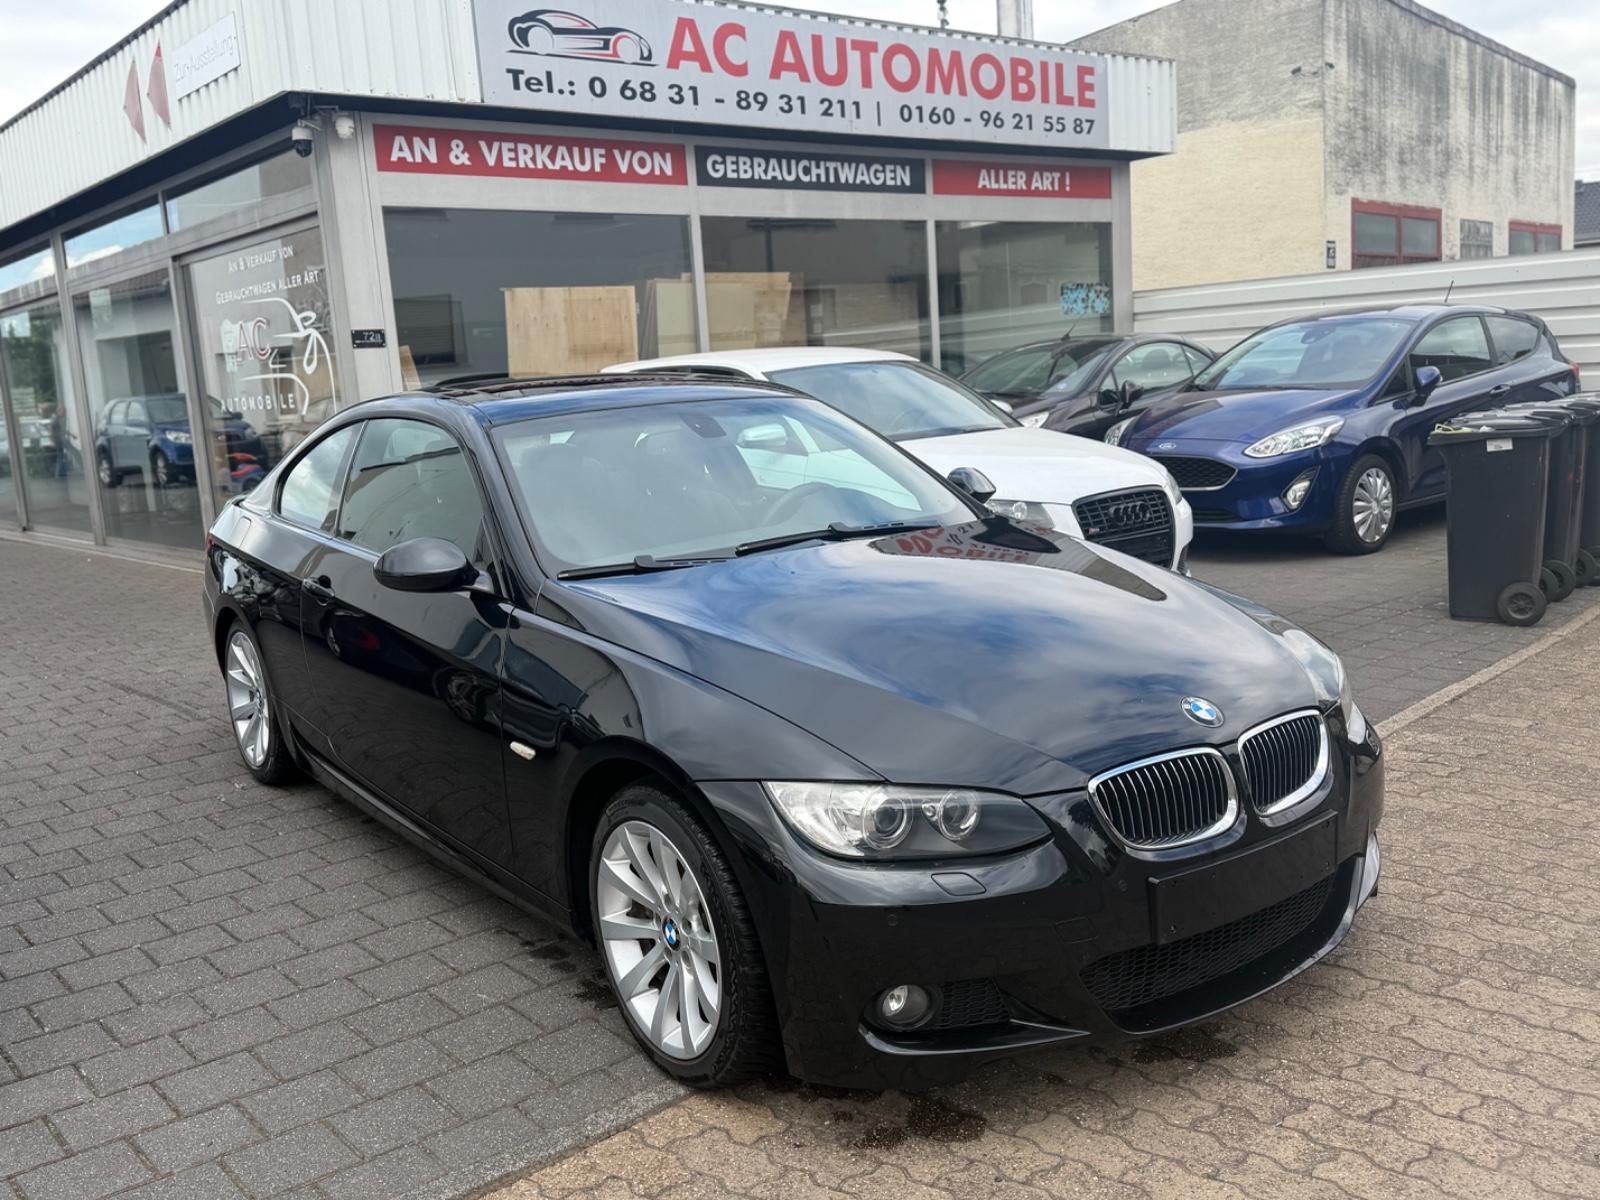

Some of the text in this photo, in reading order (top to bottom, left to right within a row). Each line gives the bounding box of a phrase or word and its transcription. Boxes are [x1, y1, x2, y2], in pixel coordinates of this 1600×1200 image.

[666, 16, 1096, 108] AC AUTOMOBILE
[506, 68, 576, 96] Tel.:
[588, 76, 607, 98] 0
[619, 79, 657, 102] 68
[668, 84, 700, 106] 31
[735, 90, 768, 113] 89
[778, 94, 807, 115] 31
[820, 98, 861, 119] 211
[900, 104, 955, 125] 0160
[980, 110, 1005, 129] 96
[1012, 113, 1033, 130] 21
[1043, 116, 1066, 133] 55
[1073, 118, 1096, 135] 87
[390, 135, 673, 177] AN & VERKAUF VON
[706, 155, 911, 186] GEBRAUCHTWAGEN
[977, 168, 1027, 190] ALLER
[1031, 172, 1061, 191] ART
[246, 252, 277, 269] VERKAUF
[278, 245, 294, 259] VON
[216, 270, 319, 304] GEBRAUCHTWAGEN ALLER ART
[236, 316, 271, 363] AC
[221, 393, 296, 413] AUTOMOBILE
